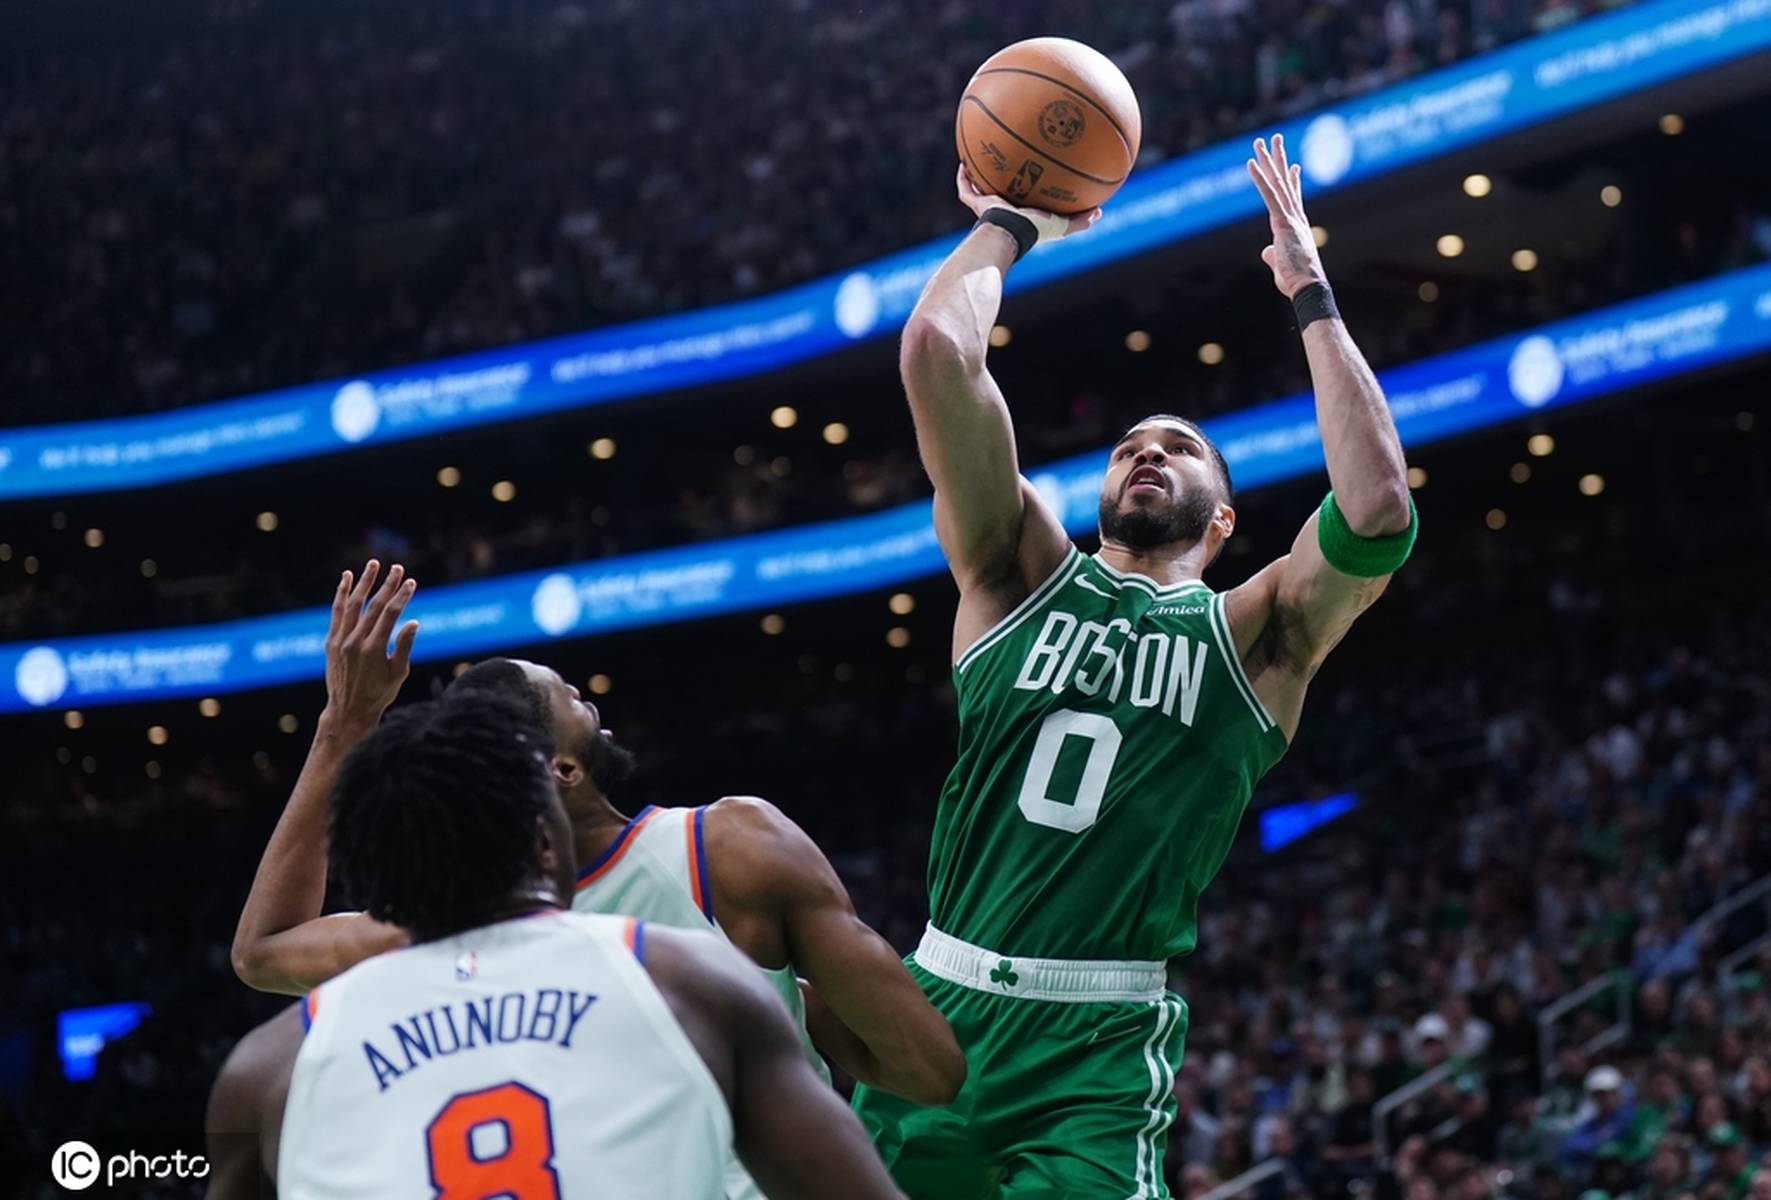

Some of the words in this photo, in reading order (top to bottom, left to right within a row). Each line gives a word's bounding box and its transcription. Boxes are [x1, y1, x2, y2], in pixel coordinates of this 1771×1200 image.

[1145, 604, 1206, 616] Amica
[1014, 611, 1208, 727] BOSTON
[1017, 708, 1123, 834] 0
[361, 989, 598, 1092] ANUNOBY
[424, 1080, 562, 1200] 8
